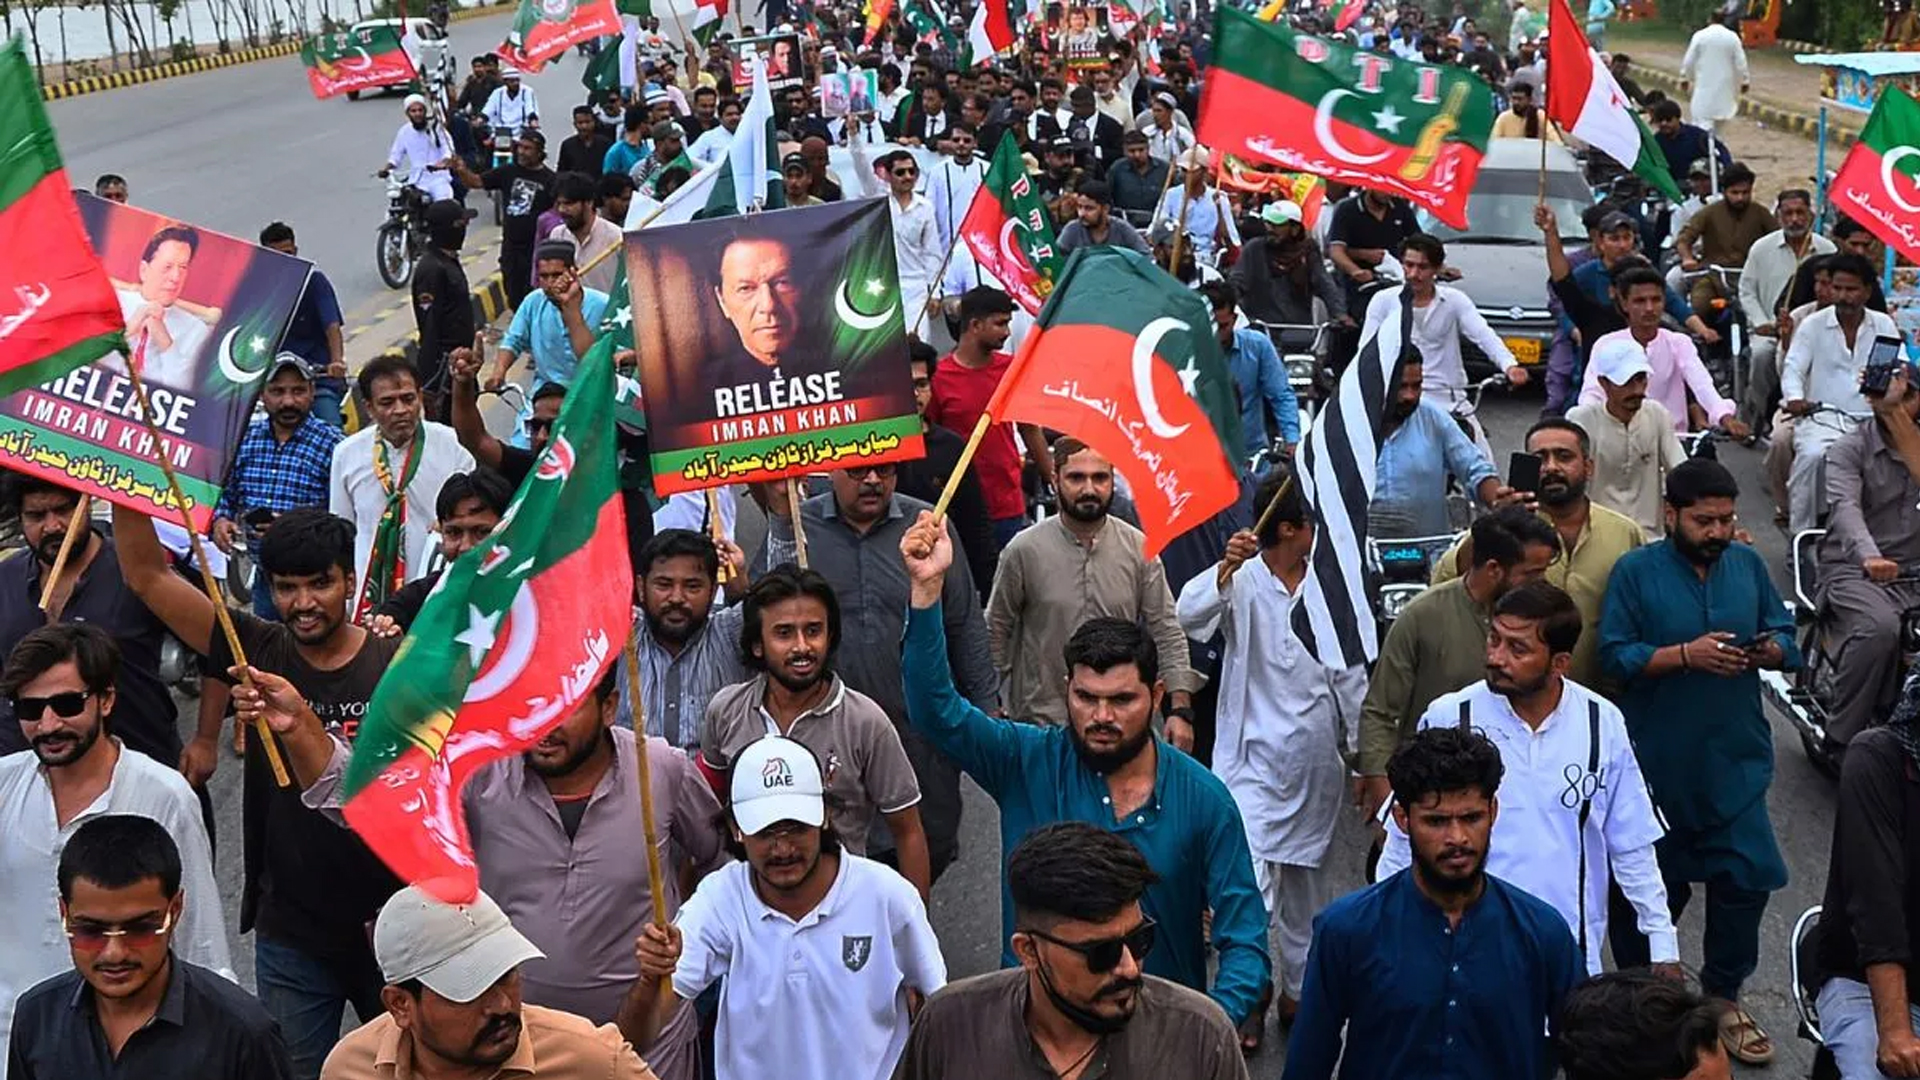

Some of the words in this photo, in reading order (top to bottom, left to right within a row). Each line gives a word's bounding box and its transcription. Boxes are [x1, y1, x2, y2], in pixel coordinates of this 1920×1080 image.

[714, 371, 844, 418] RELEASE
[1042, 380, 1118, 423] انصاف
[22, 394, 109, 441] IMRAN
[712, 417, 786, 442] IMRAN
[797, 403, 858, 429] KHAN
[763, 774, 795, 789] UAE
[1560, 763, 1608, 809] 804
